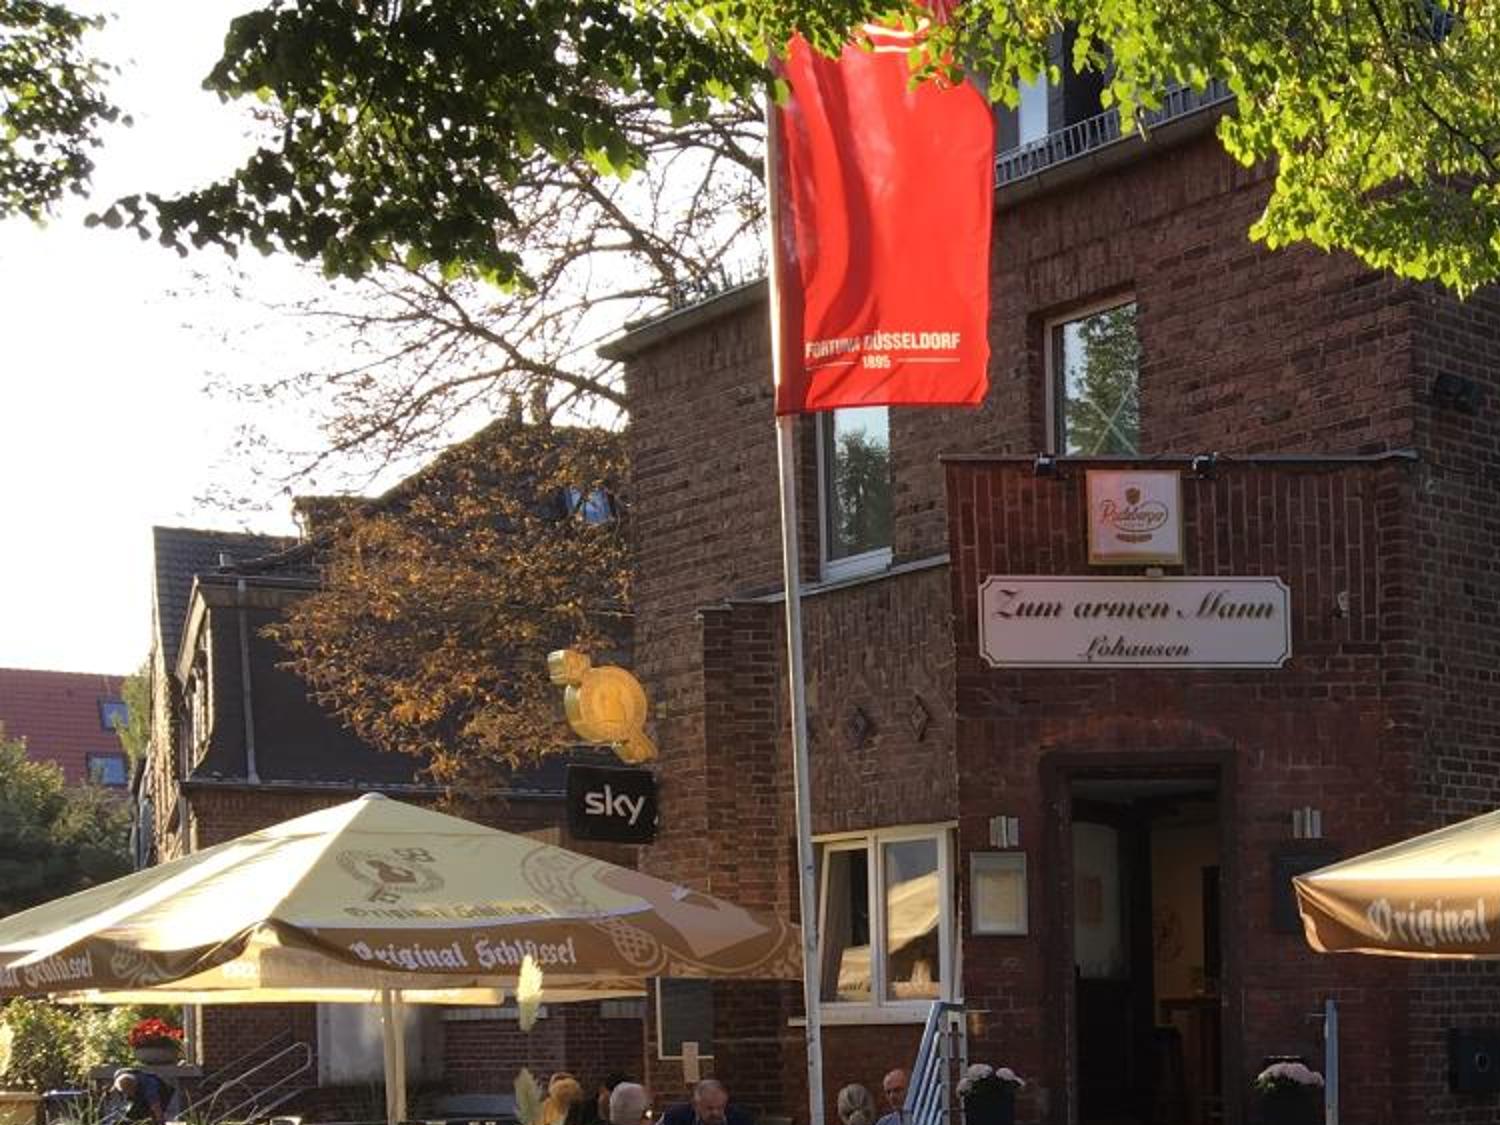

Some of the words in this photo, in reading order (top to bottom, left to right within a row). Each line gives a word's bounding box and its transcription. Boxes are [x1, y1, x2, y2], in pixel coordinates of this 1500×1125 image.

[863, 329, 960, 350] DÜSSELDORF
[863, 354, 891, 369] 1895
[994, 588, 1063, 619] Zum
[1073, 601, 1169, 619] armen
[1175, 588, 1275, 619] Mann
[1076, 634, 1192, 661] Lohausen
[585, 784, 645, 825] sky
[1368, 897, 1490, 946] Original
[350, 940, 469, 970] Original
